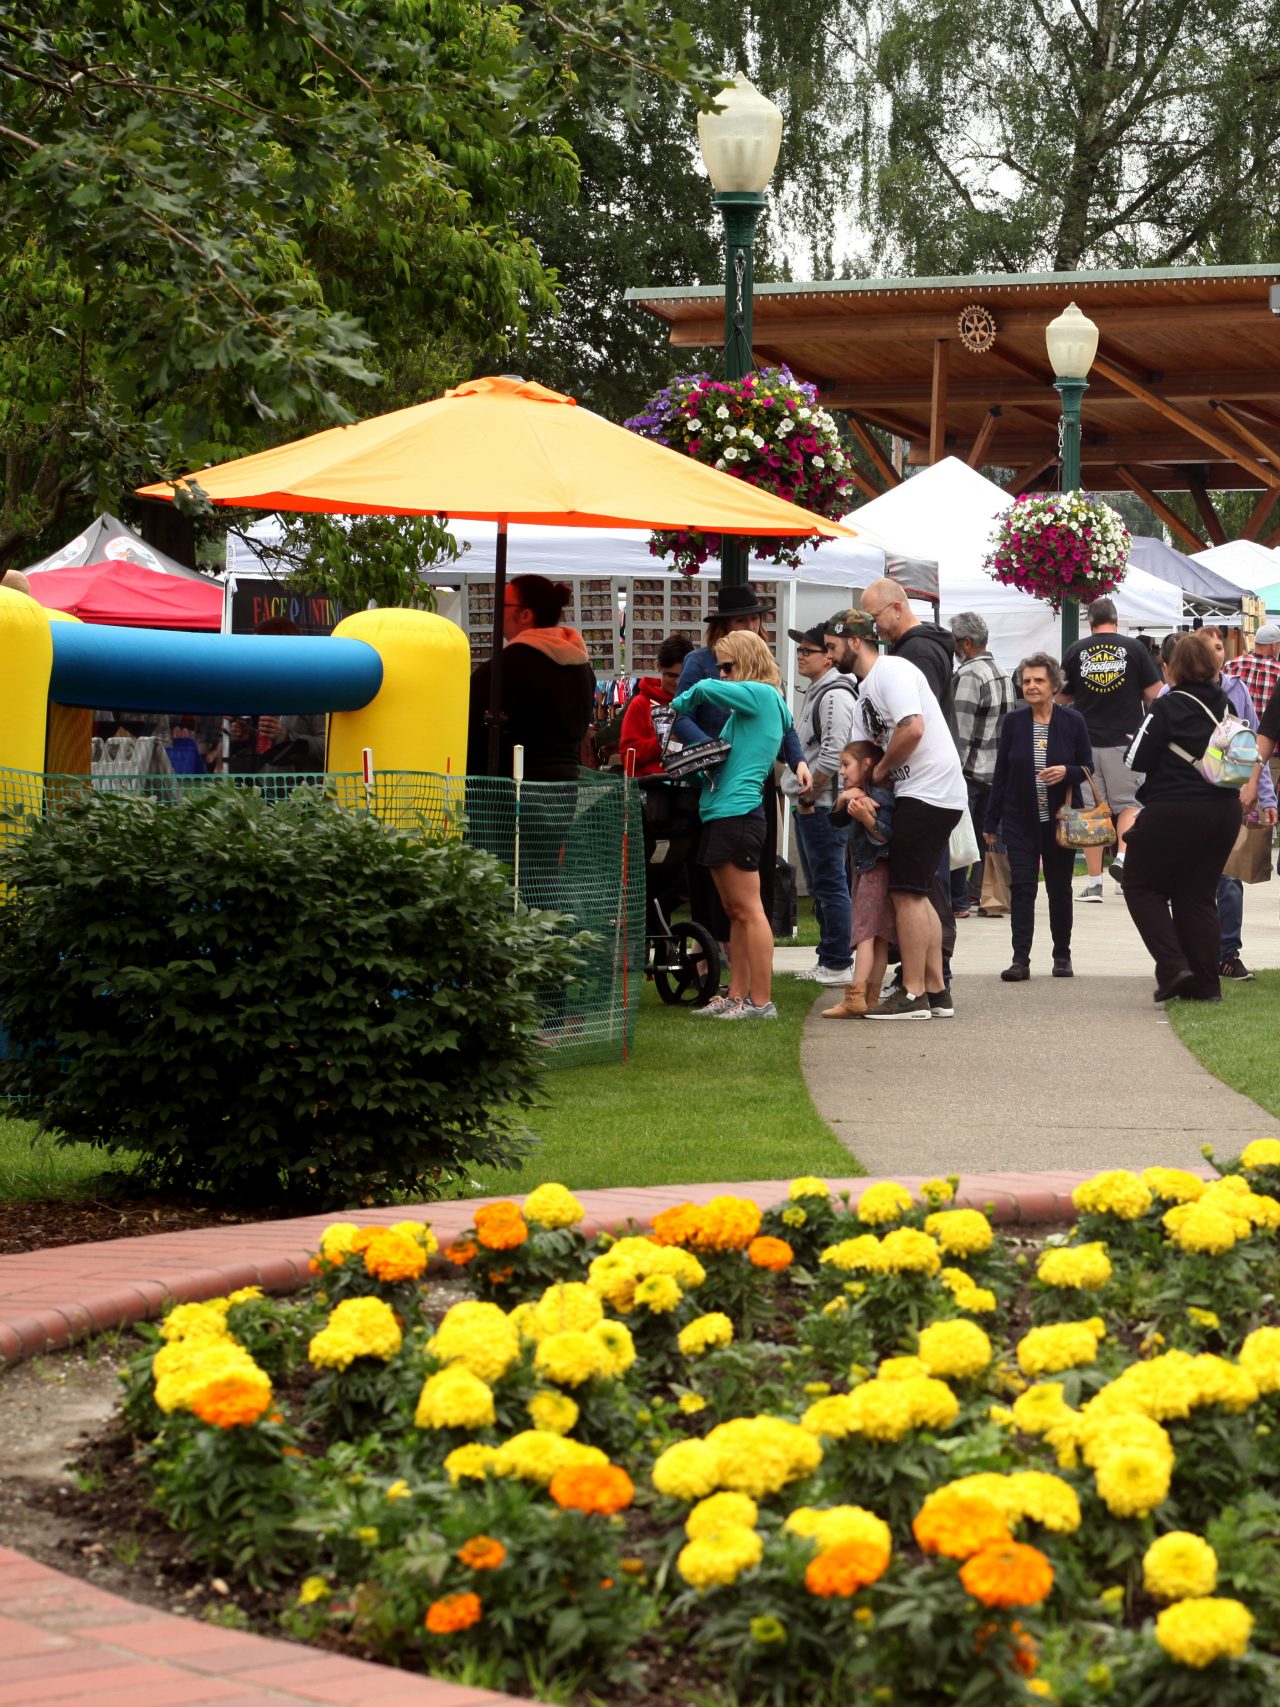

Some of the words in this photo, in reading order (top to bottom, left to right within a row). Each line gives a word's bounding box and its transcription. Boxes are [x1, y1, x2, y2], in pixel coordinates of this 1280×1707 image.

[253, 593, 288, 625] FACE
[1091, 653, 1115, 661] DRAG
[1080, 660, 1127, 677] Goodguys
[1088, 672, 1119, 684] RACING
